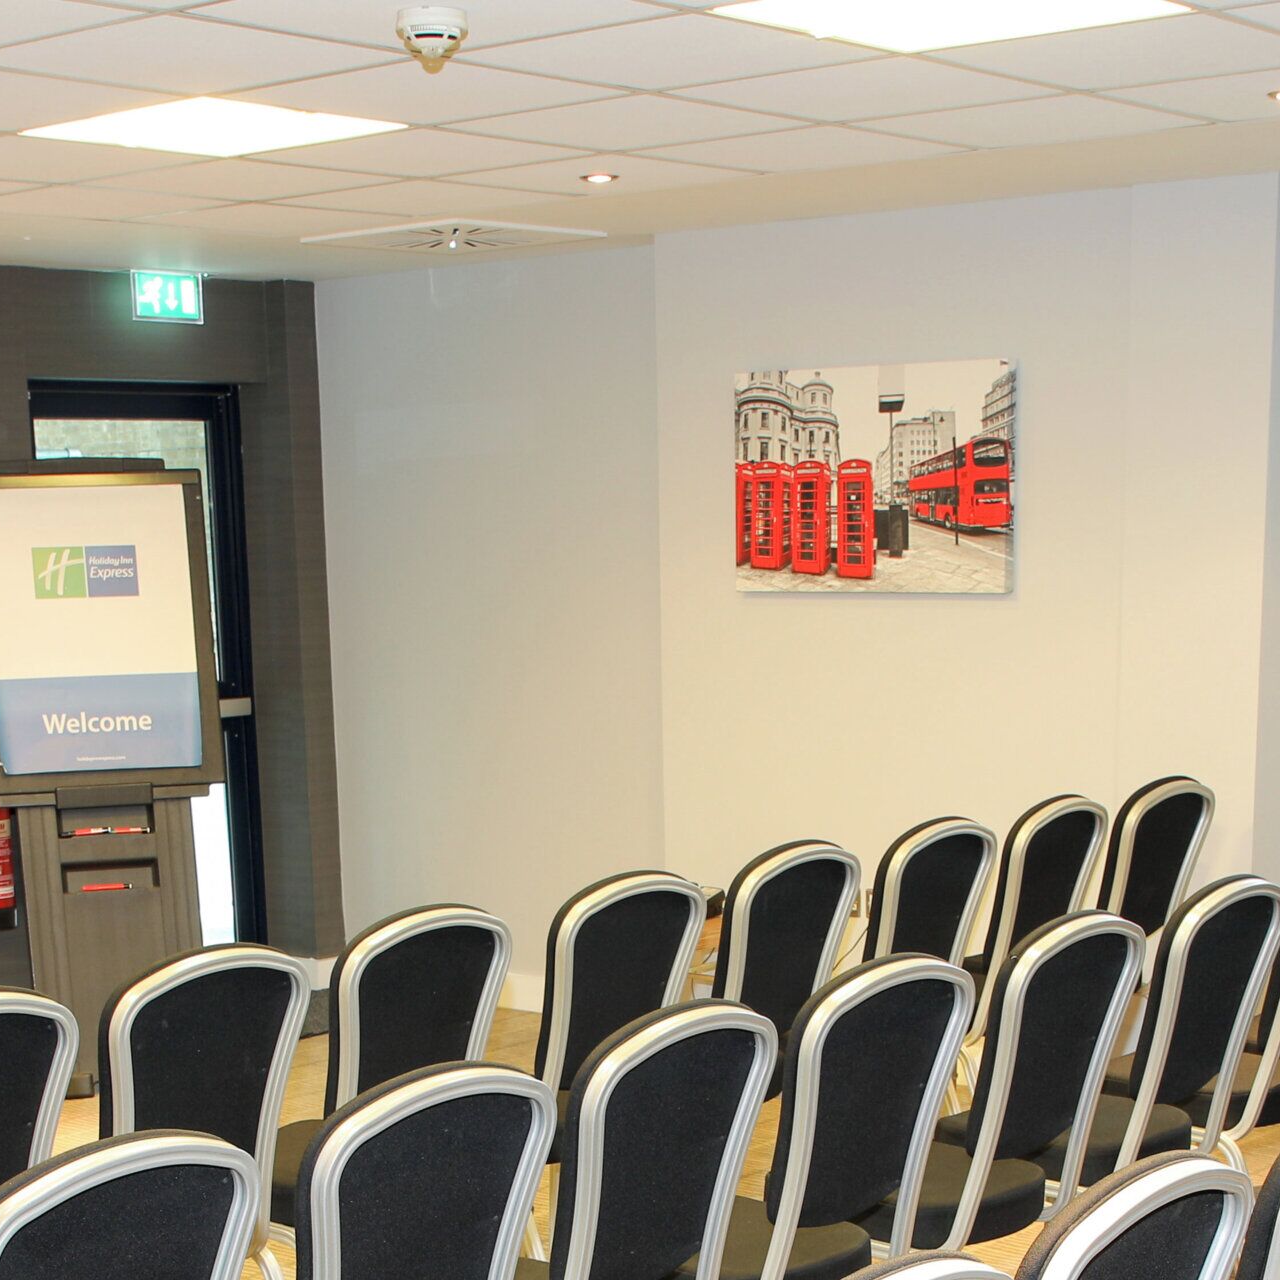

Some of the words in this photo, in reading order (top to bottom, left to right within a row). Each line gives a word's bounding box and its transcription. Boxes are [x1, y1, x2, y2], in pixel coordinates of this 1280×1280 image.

[89, 556, 119, 566] Holiday
[120, 555, 133, 565] Inn
[90, 566, 134, 581] Express
[42, 711, 152, 734] Welcome
